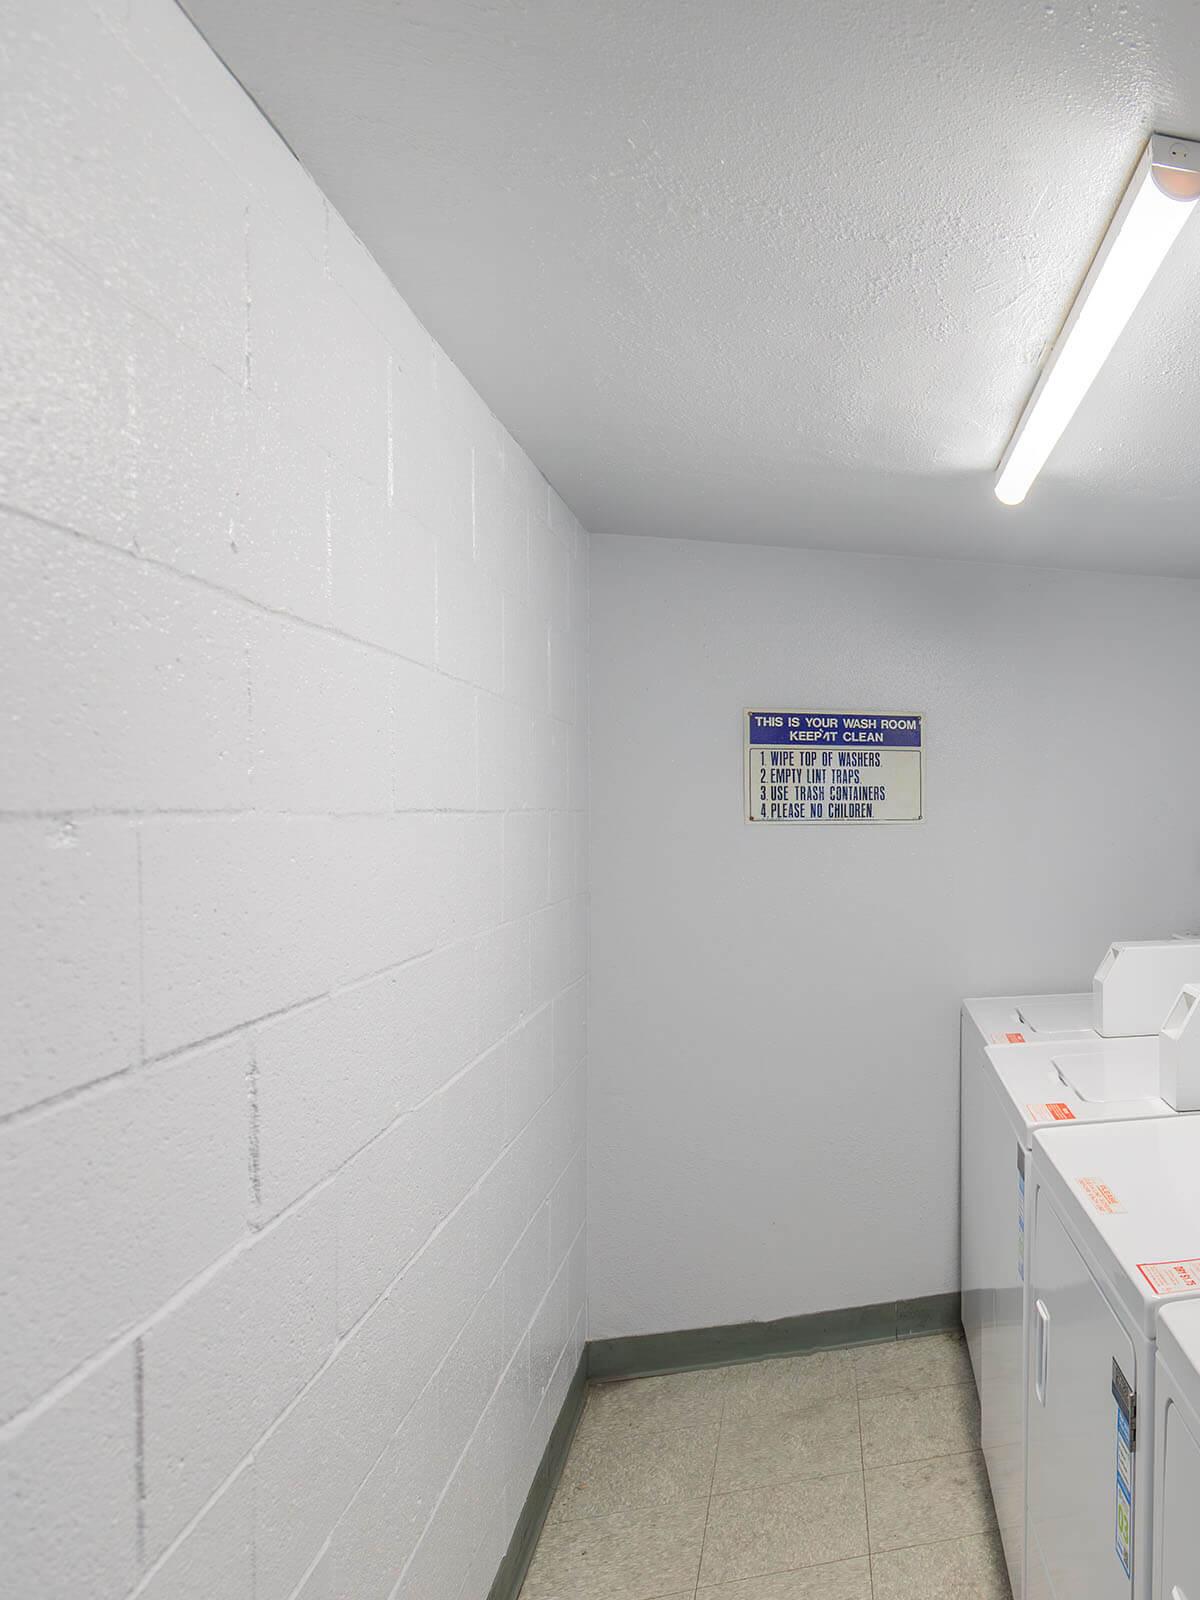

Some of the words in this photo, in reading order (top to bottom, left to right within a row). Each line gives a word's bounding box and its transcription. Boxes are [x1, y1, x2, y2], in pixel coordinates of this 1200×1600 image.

[755, 716, 783, 727] THIS
[788, 717, 800, 727] IS
[805, 717, 838, 729] YOUR
[843, 718, 877, 729] WASH
[881, 719, 917, 730] ROOM
[790, 731, 822, 741] KEEP
[843, 732, 884, 742] CLEAN
[760, 752, 767, 767] 1.
[770, 751, 794, 767] WIPE
[800, 752, 817, 767] TOP
[822, 752, 833, 767] OF
[760, 769, 768, 783] 2.
[770, 769, 802, 783] EMPTY
[807, 769, 826, 784] LINT
[760, 786, 769, 800] 3.
[770, 786, 789, 800] USE
[795, 786, 824, 800] TRASH
[770, 803, 805, 818] PLEASE
[810, 803, 823, 818] NO
